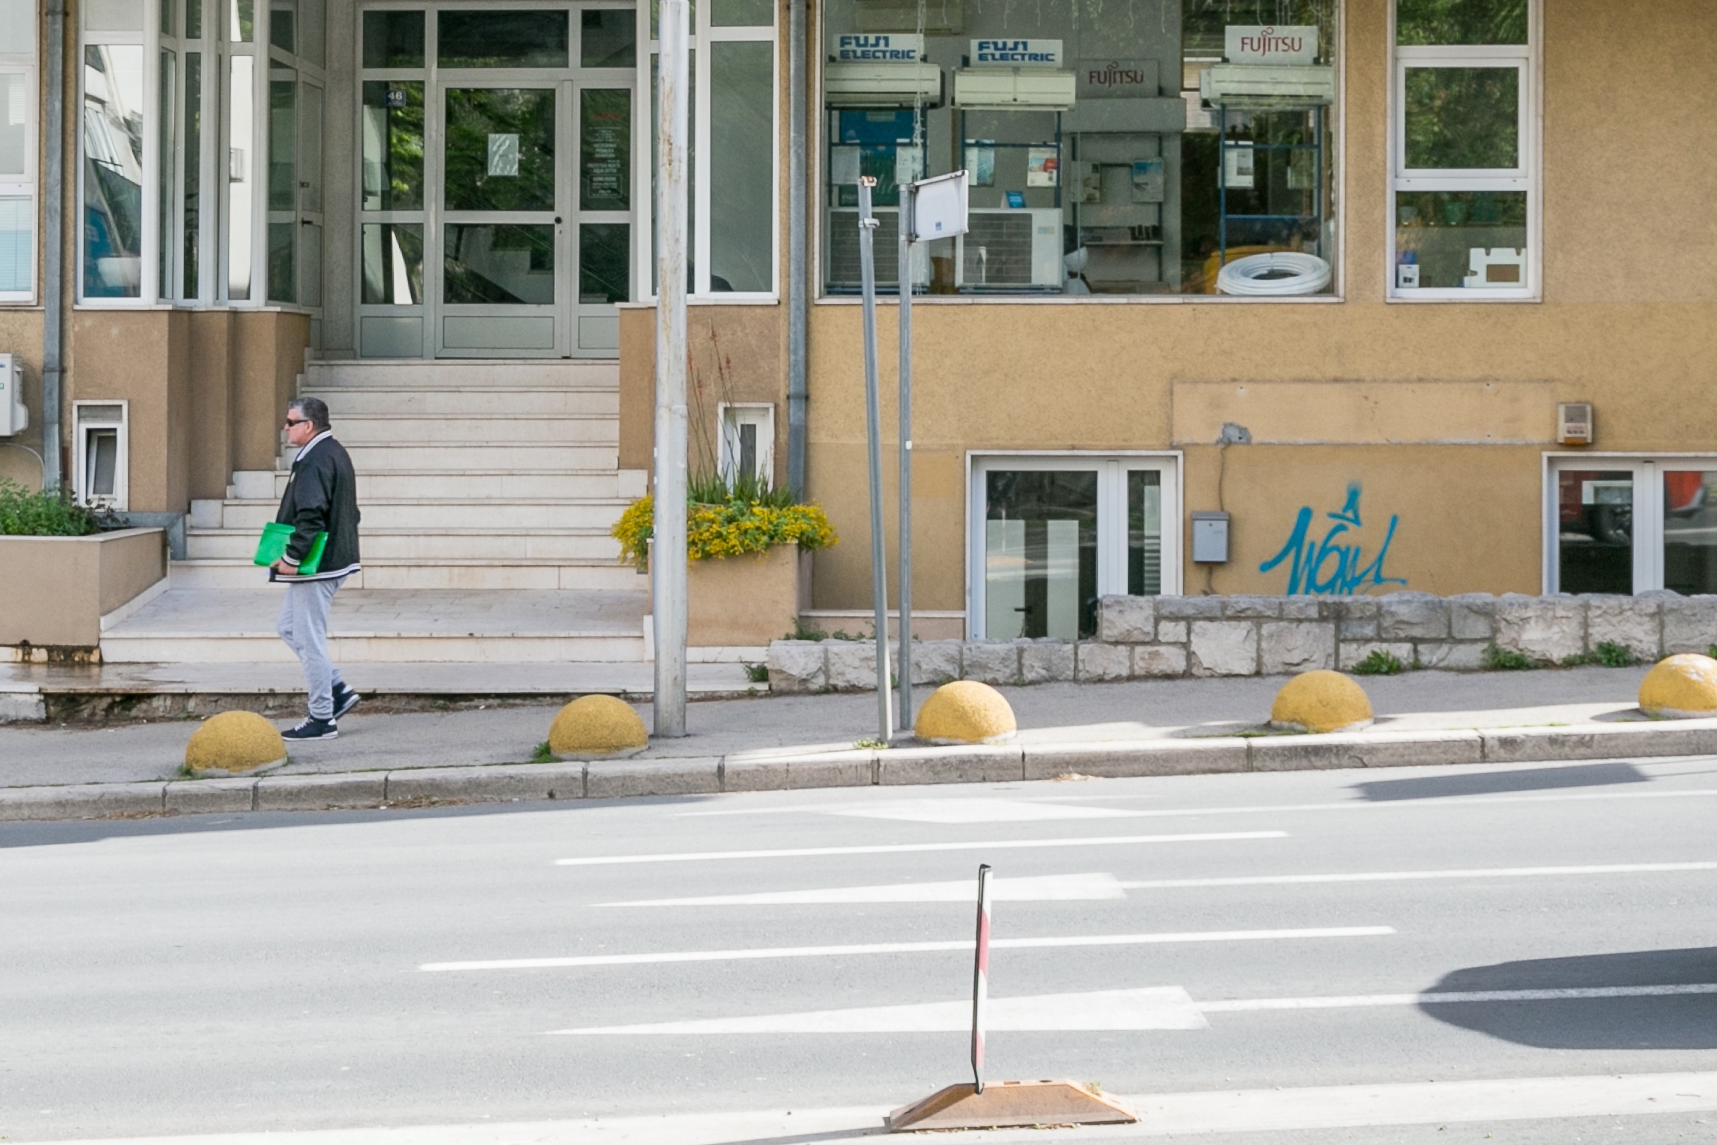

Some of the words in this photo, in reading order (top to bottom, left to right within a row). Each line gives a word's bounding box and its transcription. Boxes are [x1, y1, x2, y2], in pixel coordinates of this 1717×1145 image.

[840, 36, 889, 48] FUJI
[978, 41, 1028, 51] FUJI
[1241, 27, 1302, 56] FUJITSU
[840, 49, 916, 60] ELECTRIC
[978, 52, 1055, 62] ELECTRIC
[1089, 62, 1144, 88] FUJITSU
